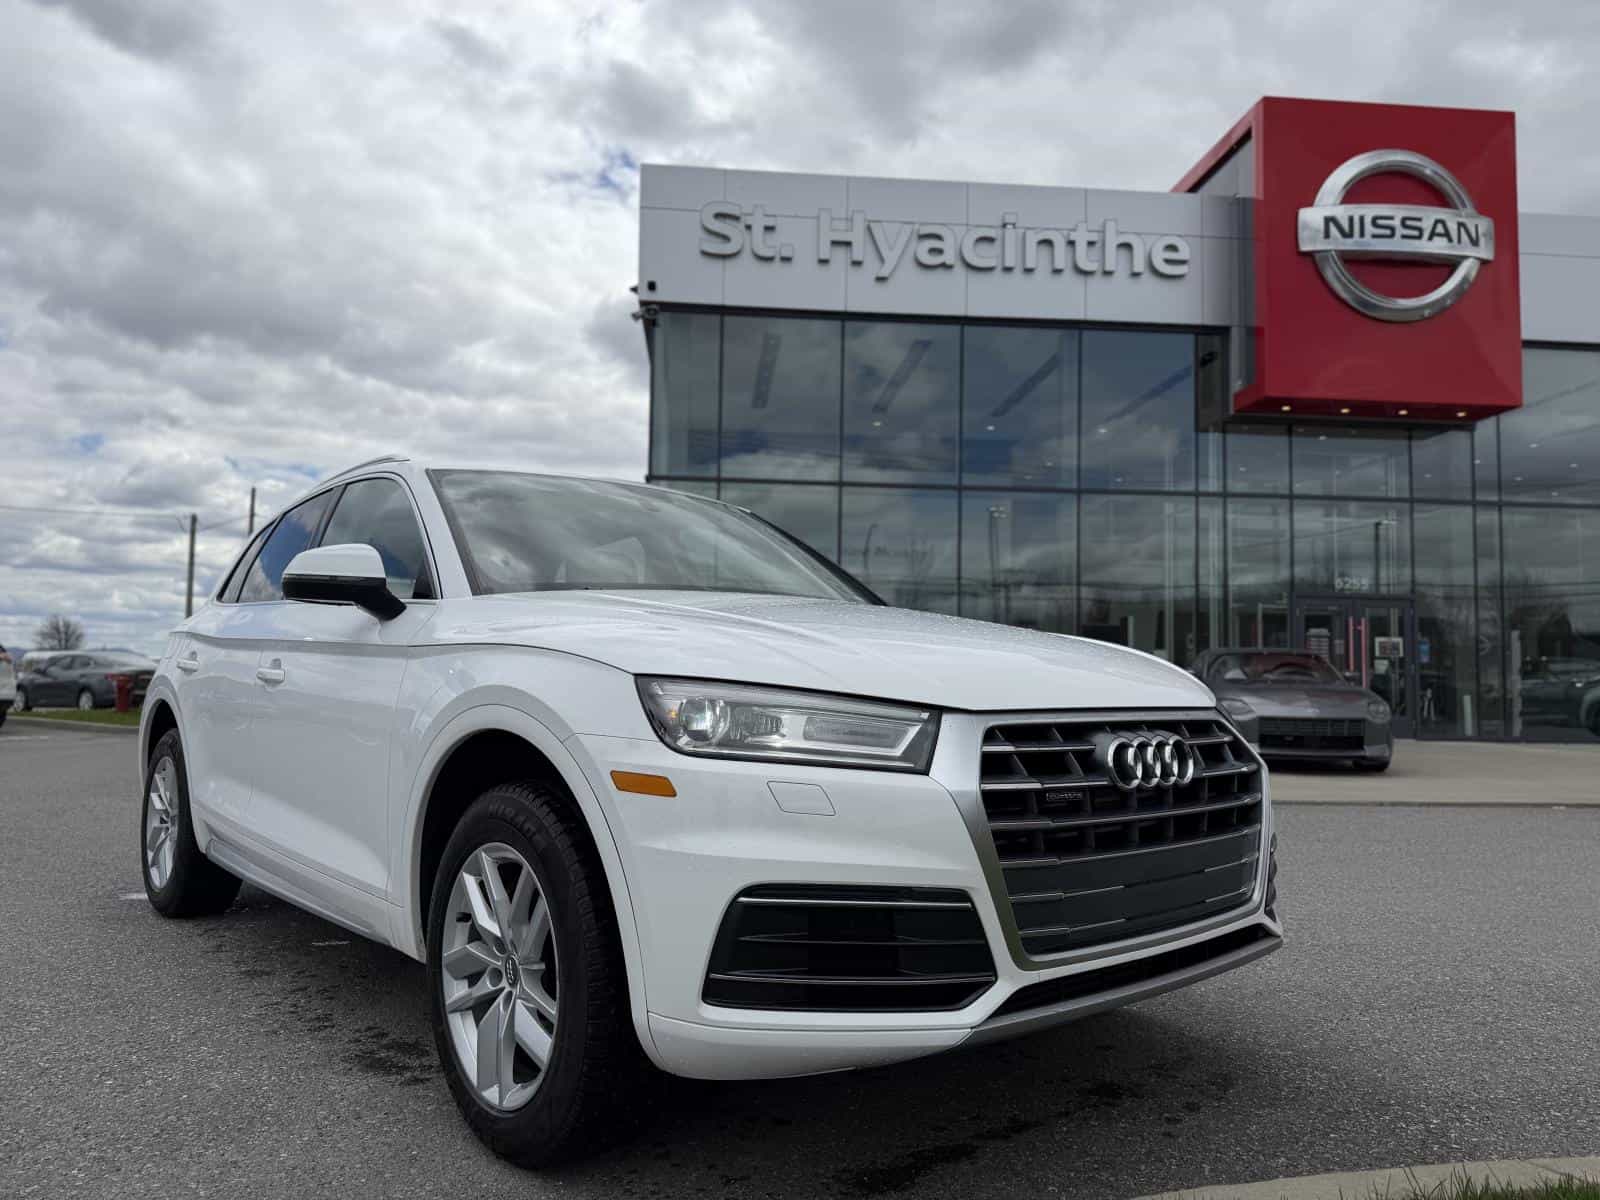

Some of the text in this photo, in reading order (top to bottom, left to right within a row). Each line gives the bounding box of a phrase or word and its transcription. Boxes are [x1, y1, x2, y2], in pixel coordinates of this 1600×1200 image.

[700, 200, 1190, 281] St. Hyacinthe
[1323, 214, 1480, 247] NISSAN
